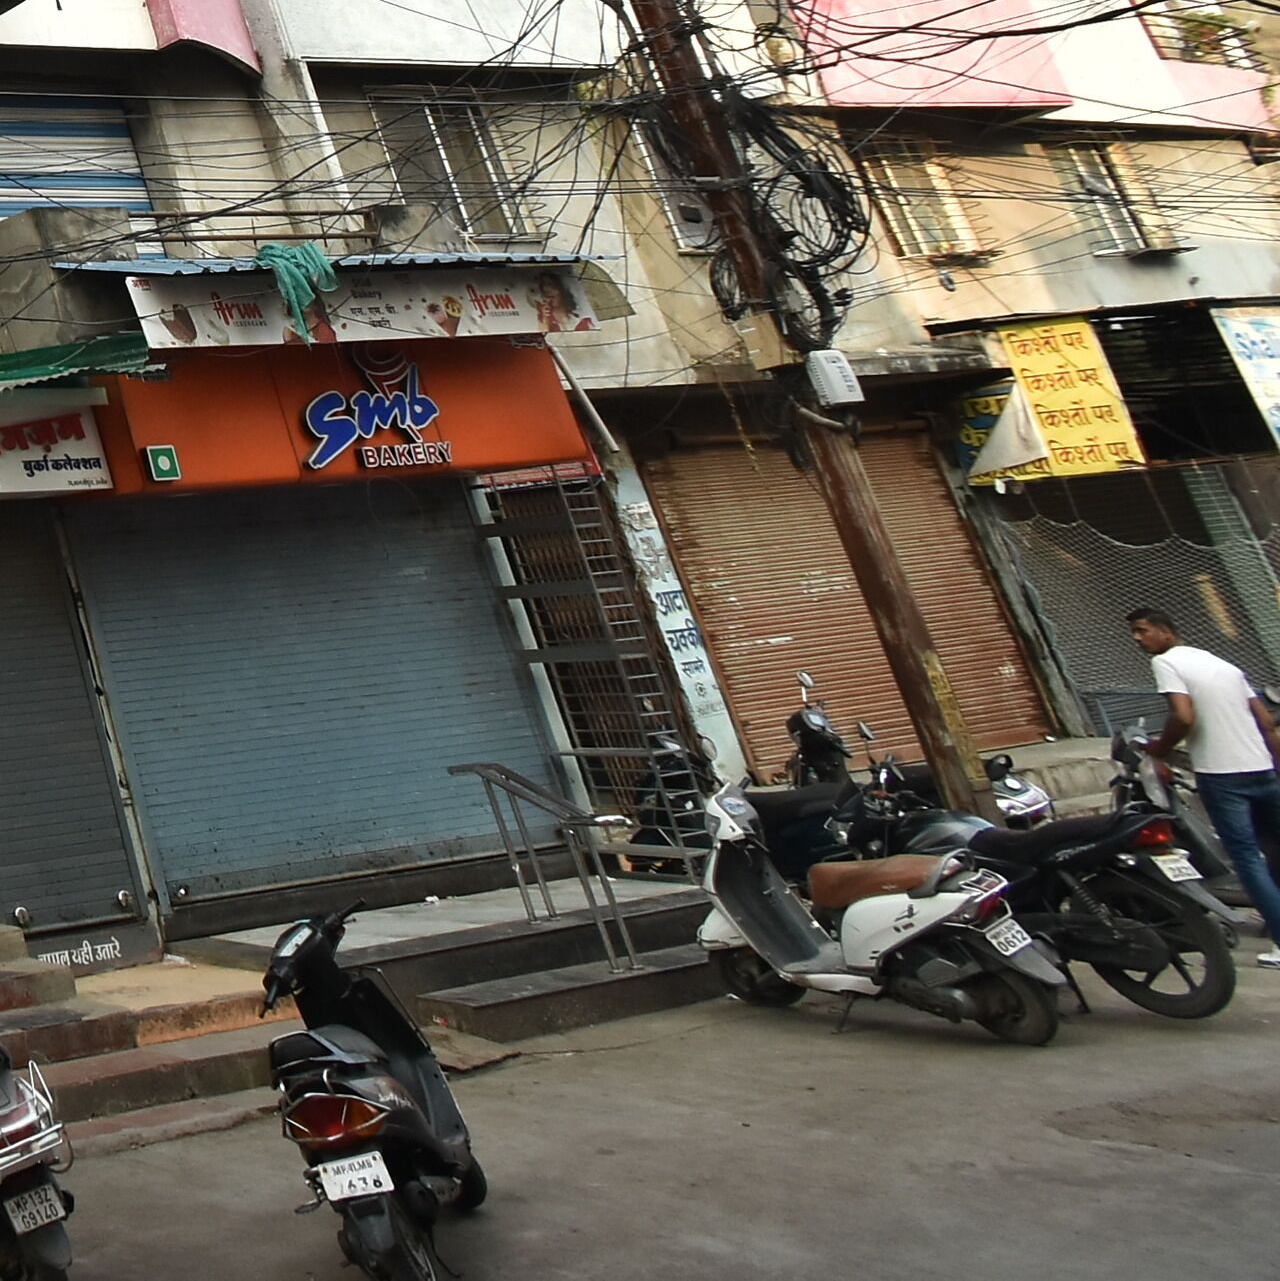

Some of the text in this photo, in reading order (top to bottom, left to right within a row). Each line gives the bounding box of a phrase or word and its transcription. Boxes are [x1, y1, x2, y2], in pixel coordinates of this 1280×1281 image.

[210, 291, 263, 326] Arun
[465, 283, 516, 319] Arun
[1061, 332, 1089, 353] पर
[1079, 367, 1104, 387] पर
[1091, 405, 1119, 424] पर
[362, 441, 453, 469] BAKERY
[1106, 441, 1134, 462] पर
[22, 453, 102, 477] बुर्का कलेक्शन
[656, 589, 689, 616] आटा
[665, 618, 704, 652] चक्की
[70, 940, 94, 965] यही
[93, 936, 122, 961] उतारे
[996, 930, 1029, 952] 0612
[21, 1203, 59, 1229] G9140
